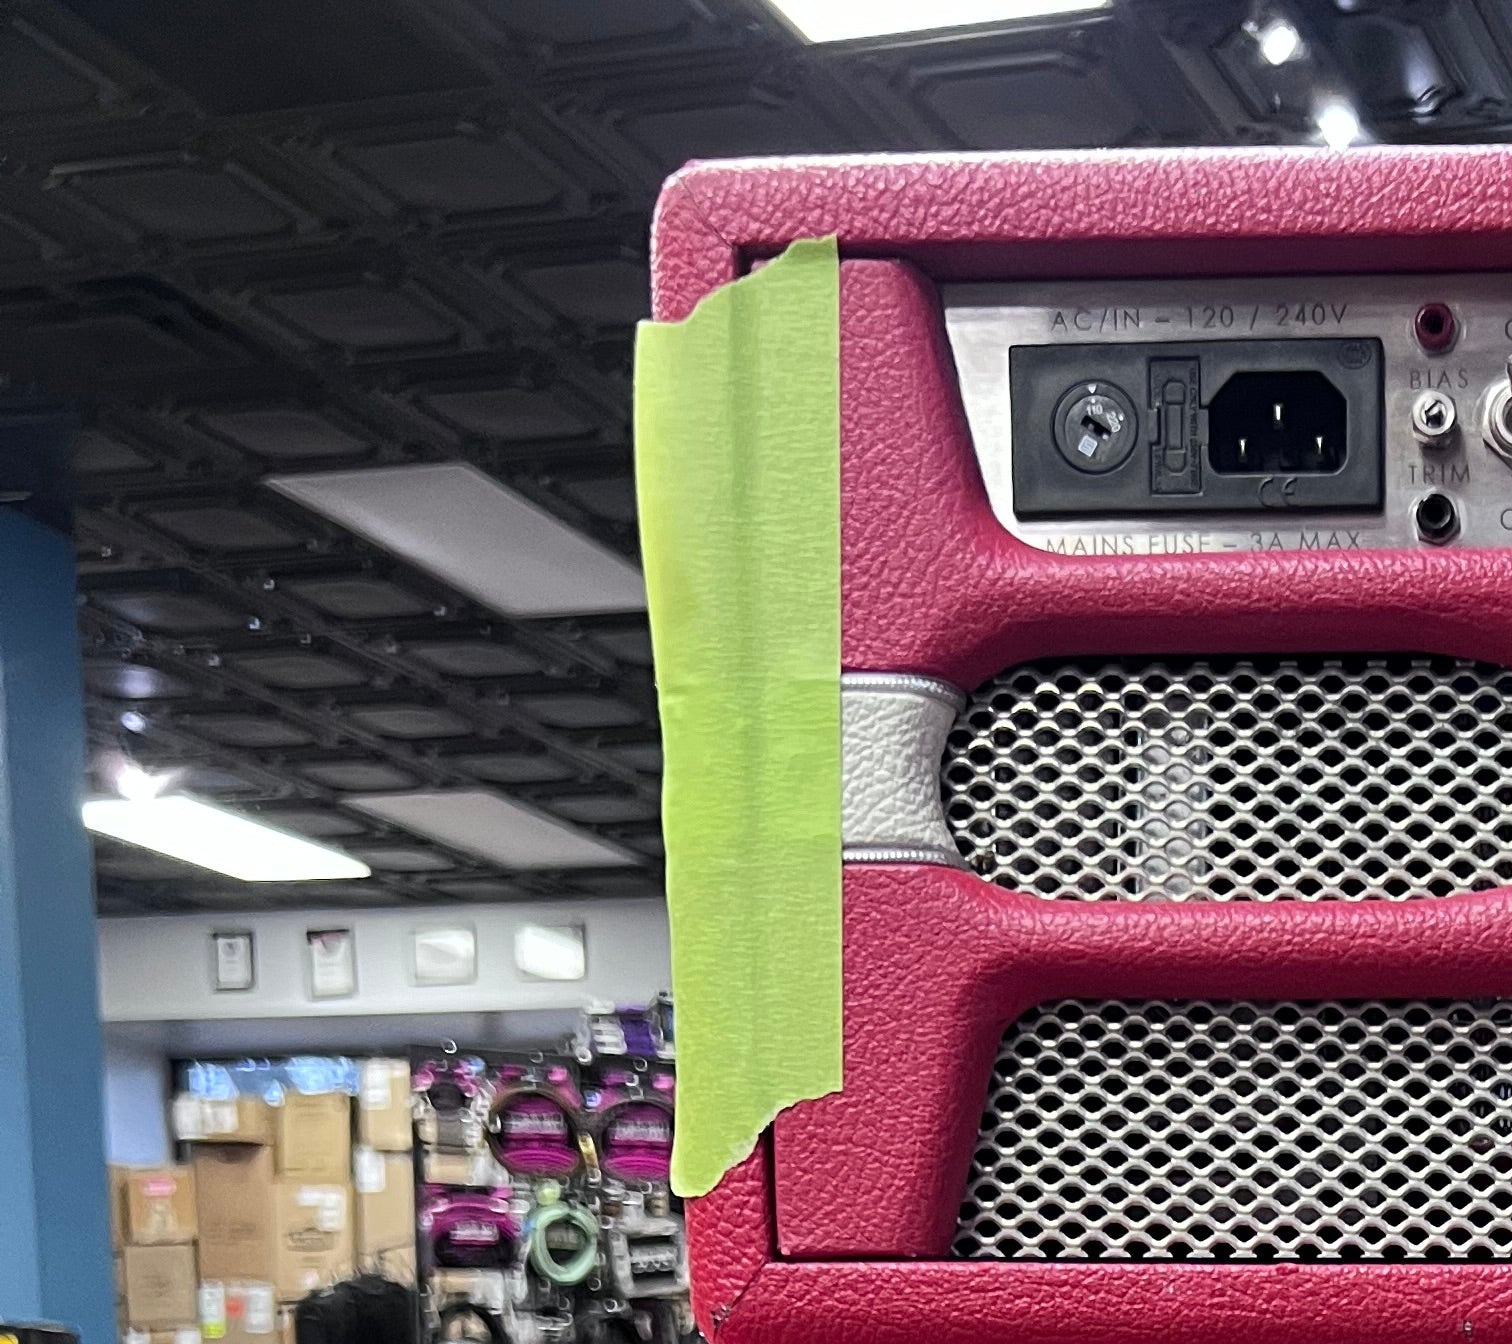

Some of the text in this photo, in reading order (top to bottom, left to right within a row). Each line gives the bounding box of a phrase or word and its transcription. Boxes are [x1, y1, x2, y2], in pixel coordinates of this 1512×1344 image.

[1051, 307, 1141, 332] AC/IN
[1186, 307, 1234, 328] 120
[1276, 303, 1348, 326] 240V
[1409, 371, 1468, 390] BIAS
[1408, 465, 1470, 484] TRIM
[1047, 537, 1134, 556] MAINS
[1250, 533, 1284, 552] 3A
[1300, 531, 1361, 551] MAX
